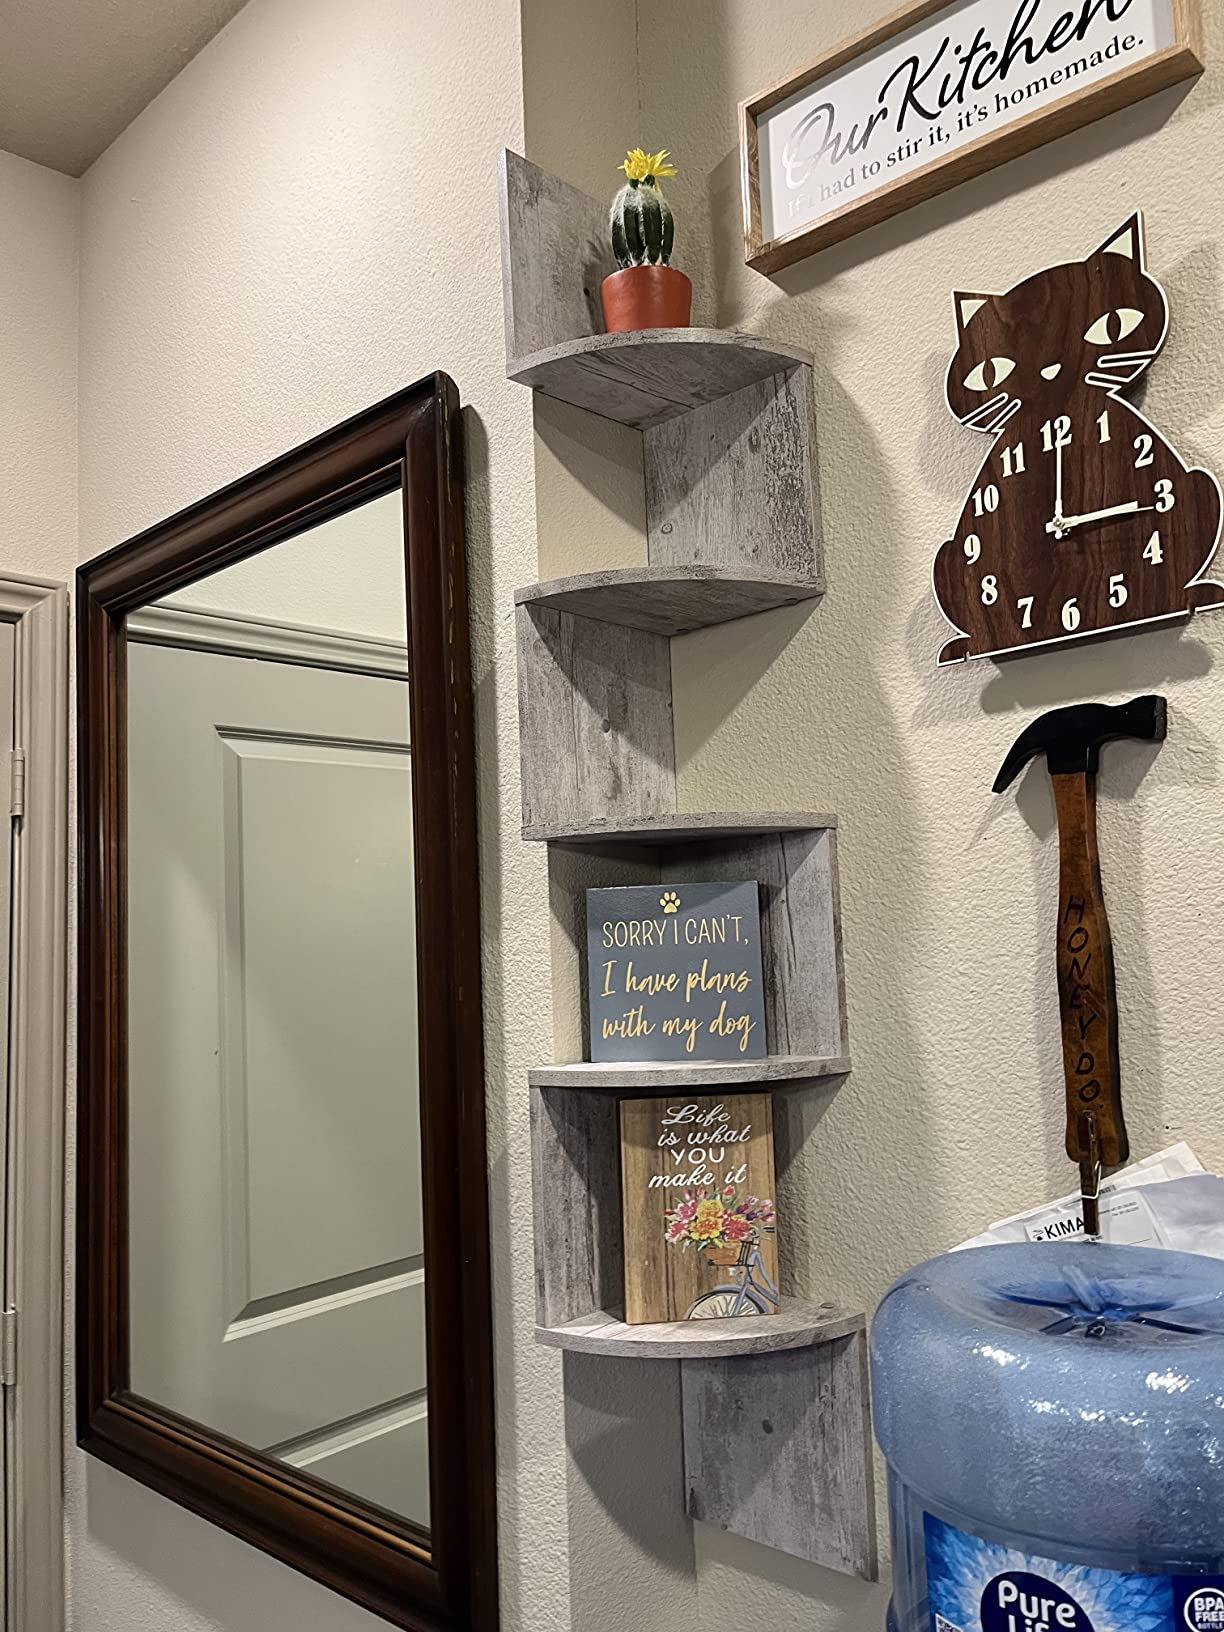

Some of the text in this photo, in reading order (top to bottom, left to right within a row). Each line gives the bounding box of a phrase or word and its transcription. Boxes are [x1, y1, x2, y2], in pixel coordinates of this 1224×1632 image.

[782, 0, 1133, 190] Our Kitchen
[820, 168, 856, 202] had
[862, 161, 881, 180] to
[886, 138, 923, 167] stir
[929, 125, 950, 145] it,
[957, 104, 988, 132] it's
[994, 33, 1145, 114] homemade.
[1039, 415, 1072, 452] 12
[1096, 410, 1111, 443] 1
[1000, 441, 1026, 478] 11
[1133, 434, 1154, 468] 2
[972, 484, 999, 517] 10
[1153, 478, 1175, 513] 3
[963, 533, 981, 565] 9
[1142, 530, 1164, 565] 4
[980, 574, 998, 606] 8
[1108, 573, 1128, 608] 5
[1017, 596, 1034, 629] 7
[1061, 597, 1081, 631] 6
[602, 914, 749, 948] SORRY I CAN'T,
[601, 958, 752, 1003] I have plans
[1063, 895, 1097, 1041] HONEY
[602, 1000, 757, 1053] with my dog
[661, 1103, 731, 1128] Life
[657, 1124, 751, 1147] is what
[670, 1146, 725, 1166] YOU
[648, 1163, 747, 1188] make it
[998, 1579, 1077, 1629] Pure
[1194, 1597, 1224, 1611] BPA
[1195, 1611, 1224, 1622] FREE
